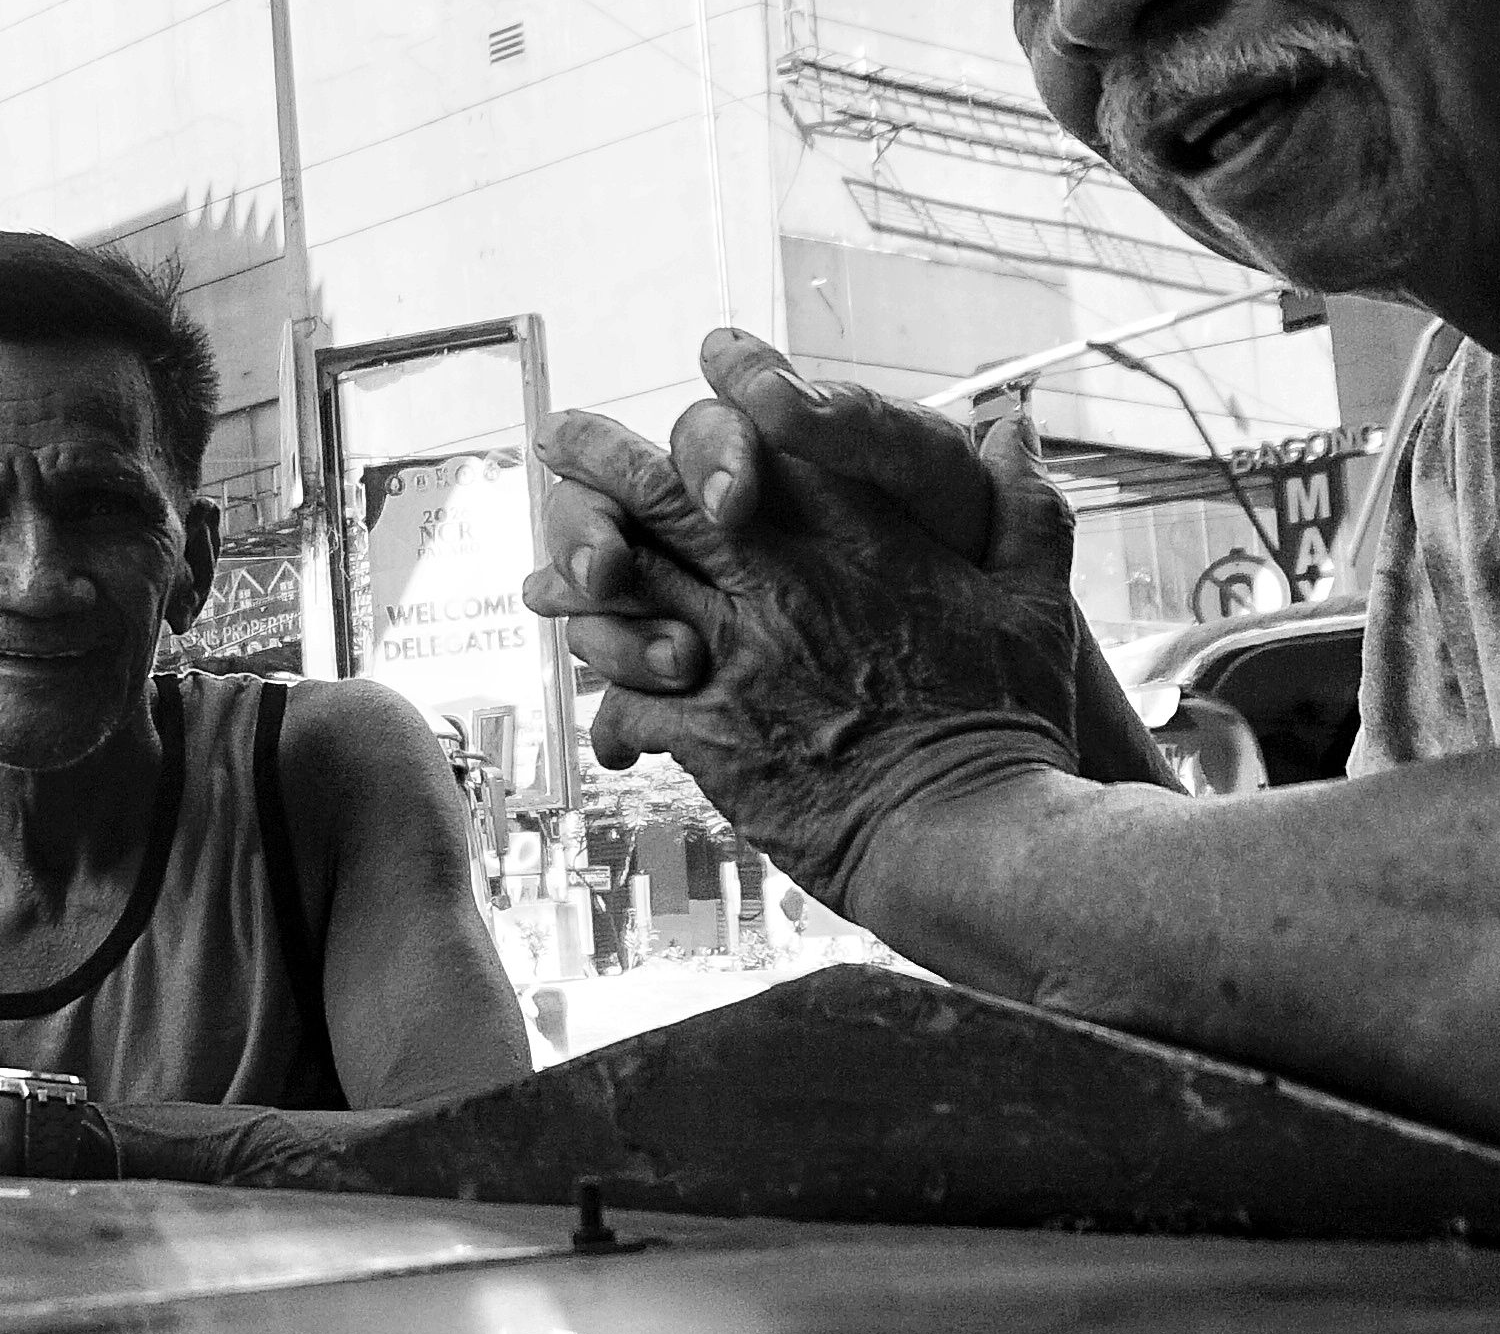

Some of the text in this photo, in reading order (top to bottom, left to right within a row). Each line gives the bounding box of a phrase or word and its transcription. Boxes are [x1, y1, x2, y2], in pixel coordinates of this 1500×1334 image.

[418, 521, 474, 547] NCR
[416, 541, 481, 561] PAARO
[385, 591, 520, 628] WELCOME
[383, 624, 527, 662] DELEGATES
